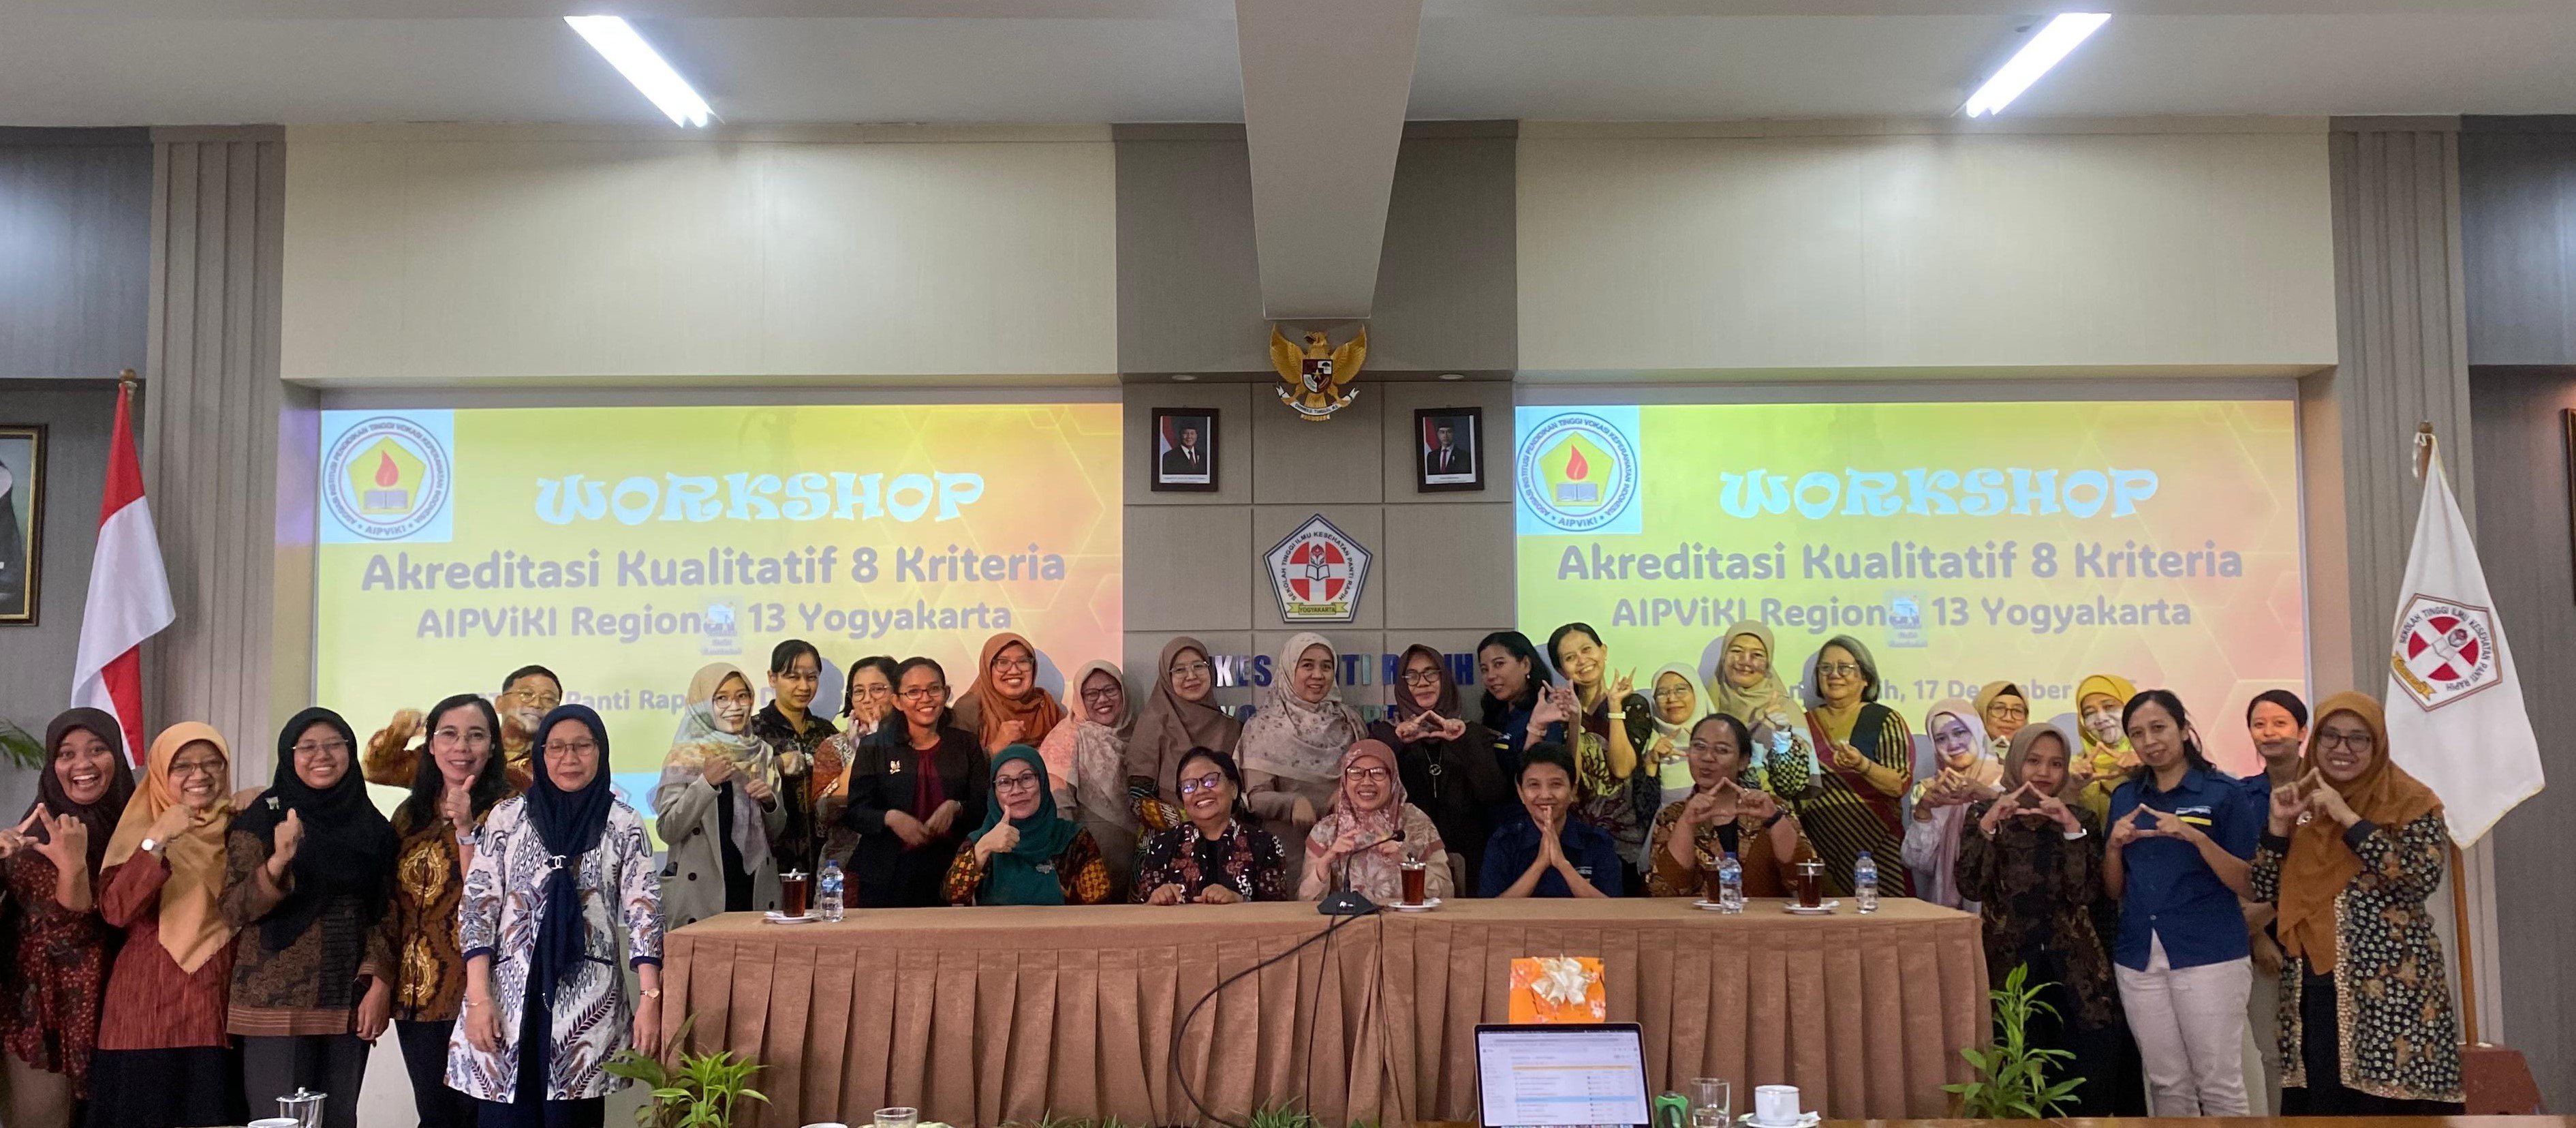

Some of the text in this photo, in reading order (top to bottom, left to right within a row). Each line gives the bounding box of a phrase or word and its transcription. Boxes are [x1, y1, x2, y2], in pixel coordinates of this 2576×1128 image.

[1558, 418, 1583, 426] TINGGI
[1584, 419, 1610, 435] VOKASI
[535, 471, 985, 525] WORKSHOP
[1719, 466, 2159, 519] WORKSHOP
[361, 542, 1066, 592] Akreditasi Kualitatif 8 Kriteria
[1281, 531, 1354, 601] SEKOLAH TINGGI ILMU KESEHATAN PANTI RAPIH
[1557, 539, 2243, 581] Akreditasi Kualitatif 8 Kriteria
[747, 603, 786, 634] 13
[798, 598, 1012, 641] Yogyakarta
[1931, 596, 1969, 626] 13
[1980, 594, 2192, 635] Yogyakarta
[2399, 613, 2423, 644] SEKOLAH
[2421, 606, 2449, 617] TINGGI
[1913, 680, 1940, 700] 17
[1947, 678, 2073, 701] Deber
